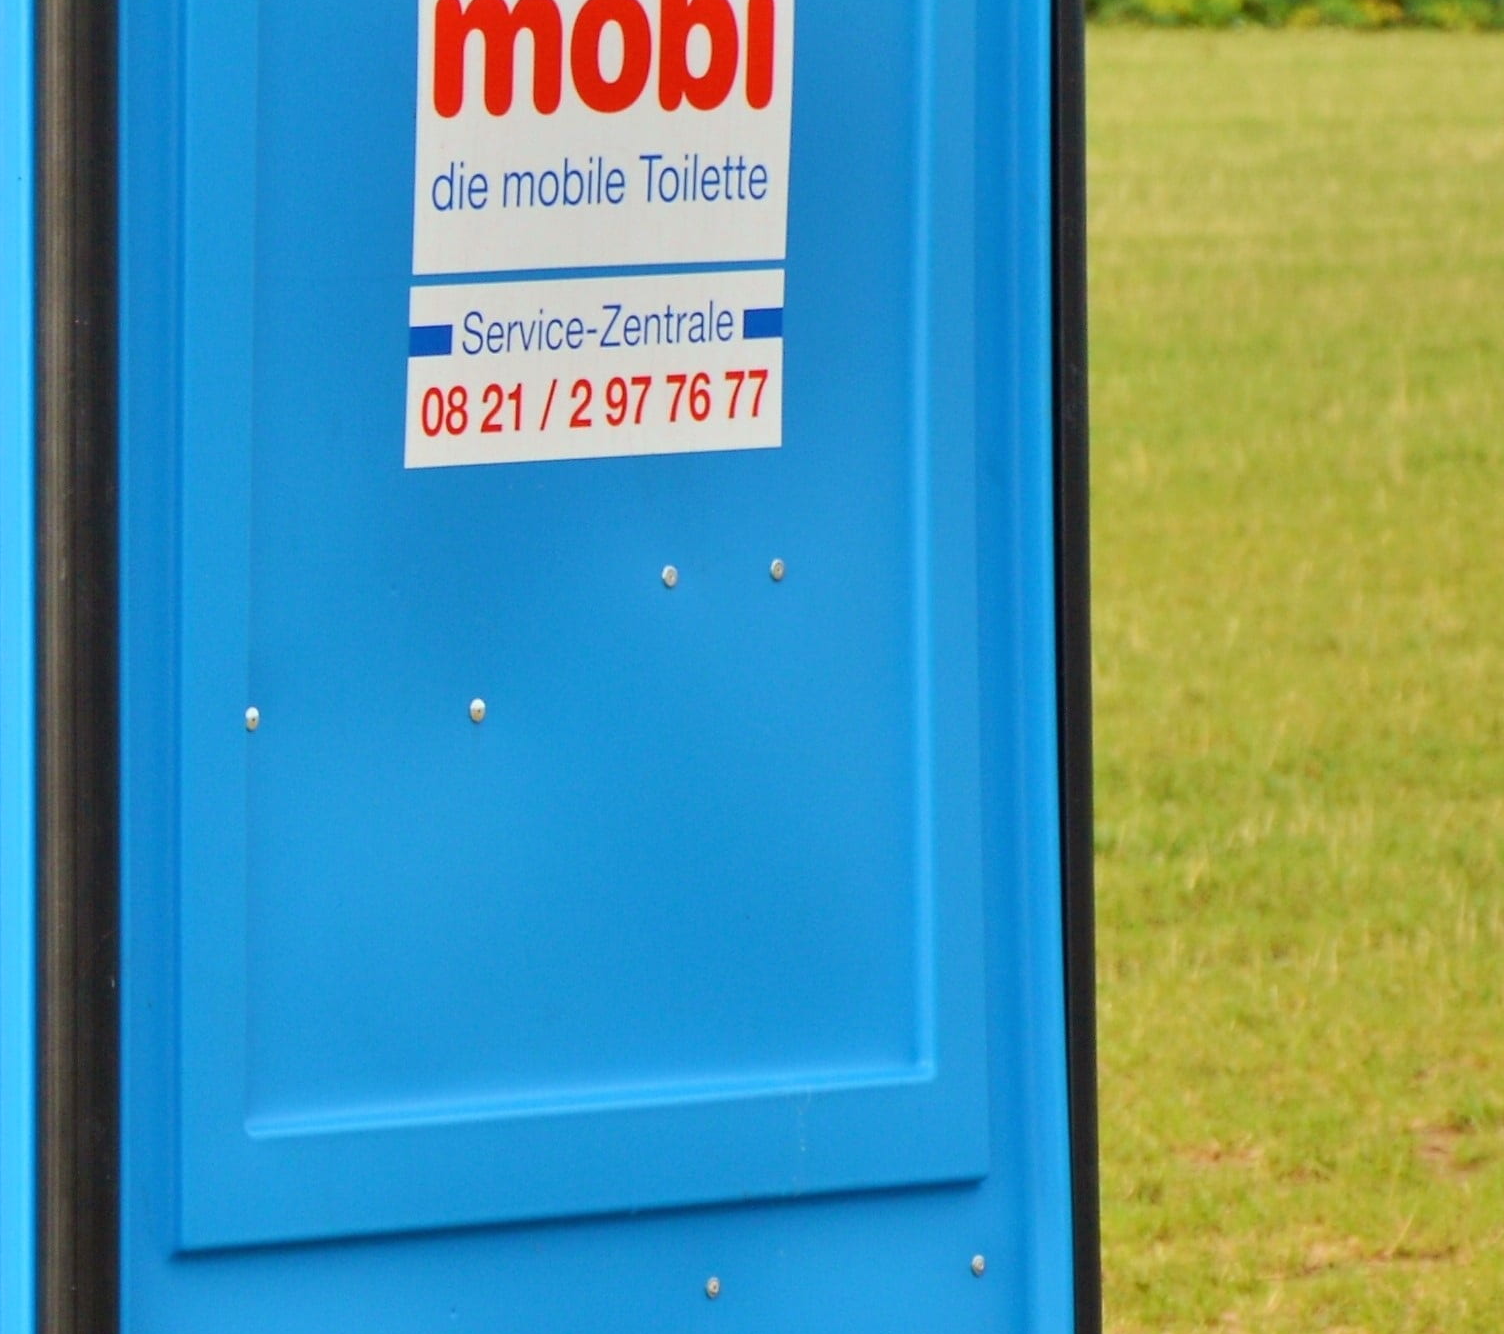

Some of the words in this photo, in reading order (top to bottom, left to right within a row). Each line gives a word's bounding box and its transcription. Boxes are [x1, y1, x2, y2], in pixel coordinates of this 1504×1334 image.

[431, 161, 489, 212] die
[502, 156, 626, 208] mobile
[638, 153, 769, 204] Toilette
[461, 300, 735, 356] Service-Zentrale
[420, 385, 469, 438] 08
[480, 383, 524, 434] 21
[568, 378, 594, 429] 2
[604, 375, 653, 427] 97
[665, 371, 712, 422] 76
[724, 369, 769, 419] 77
